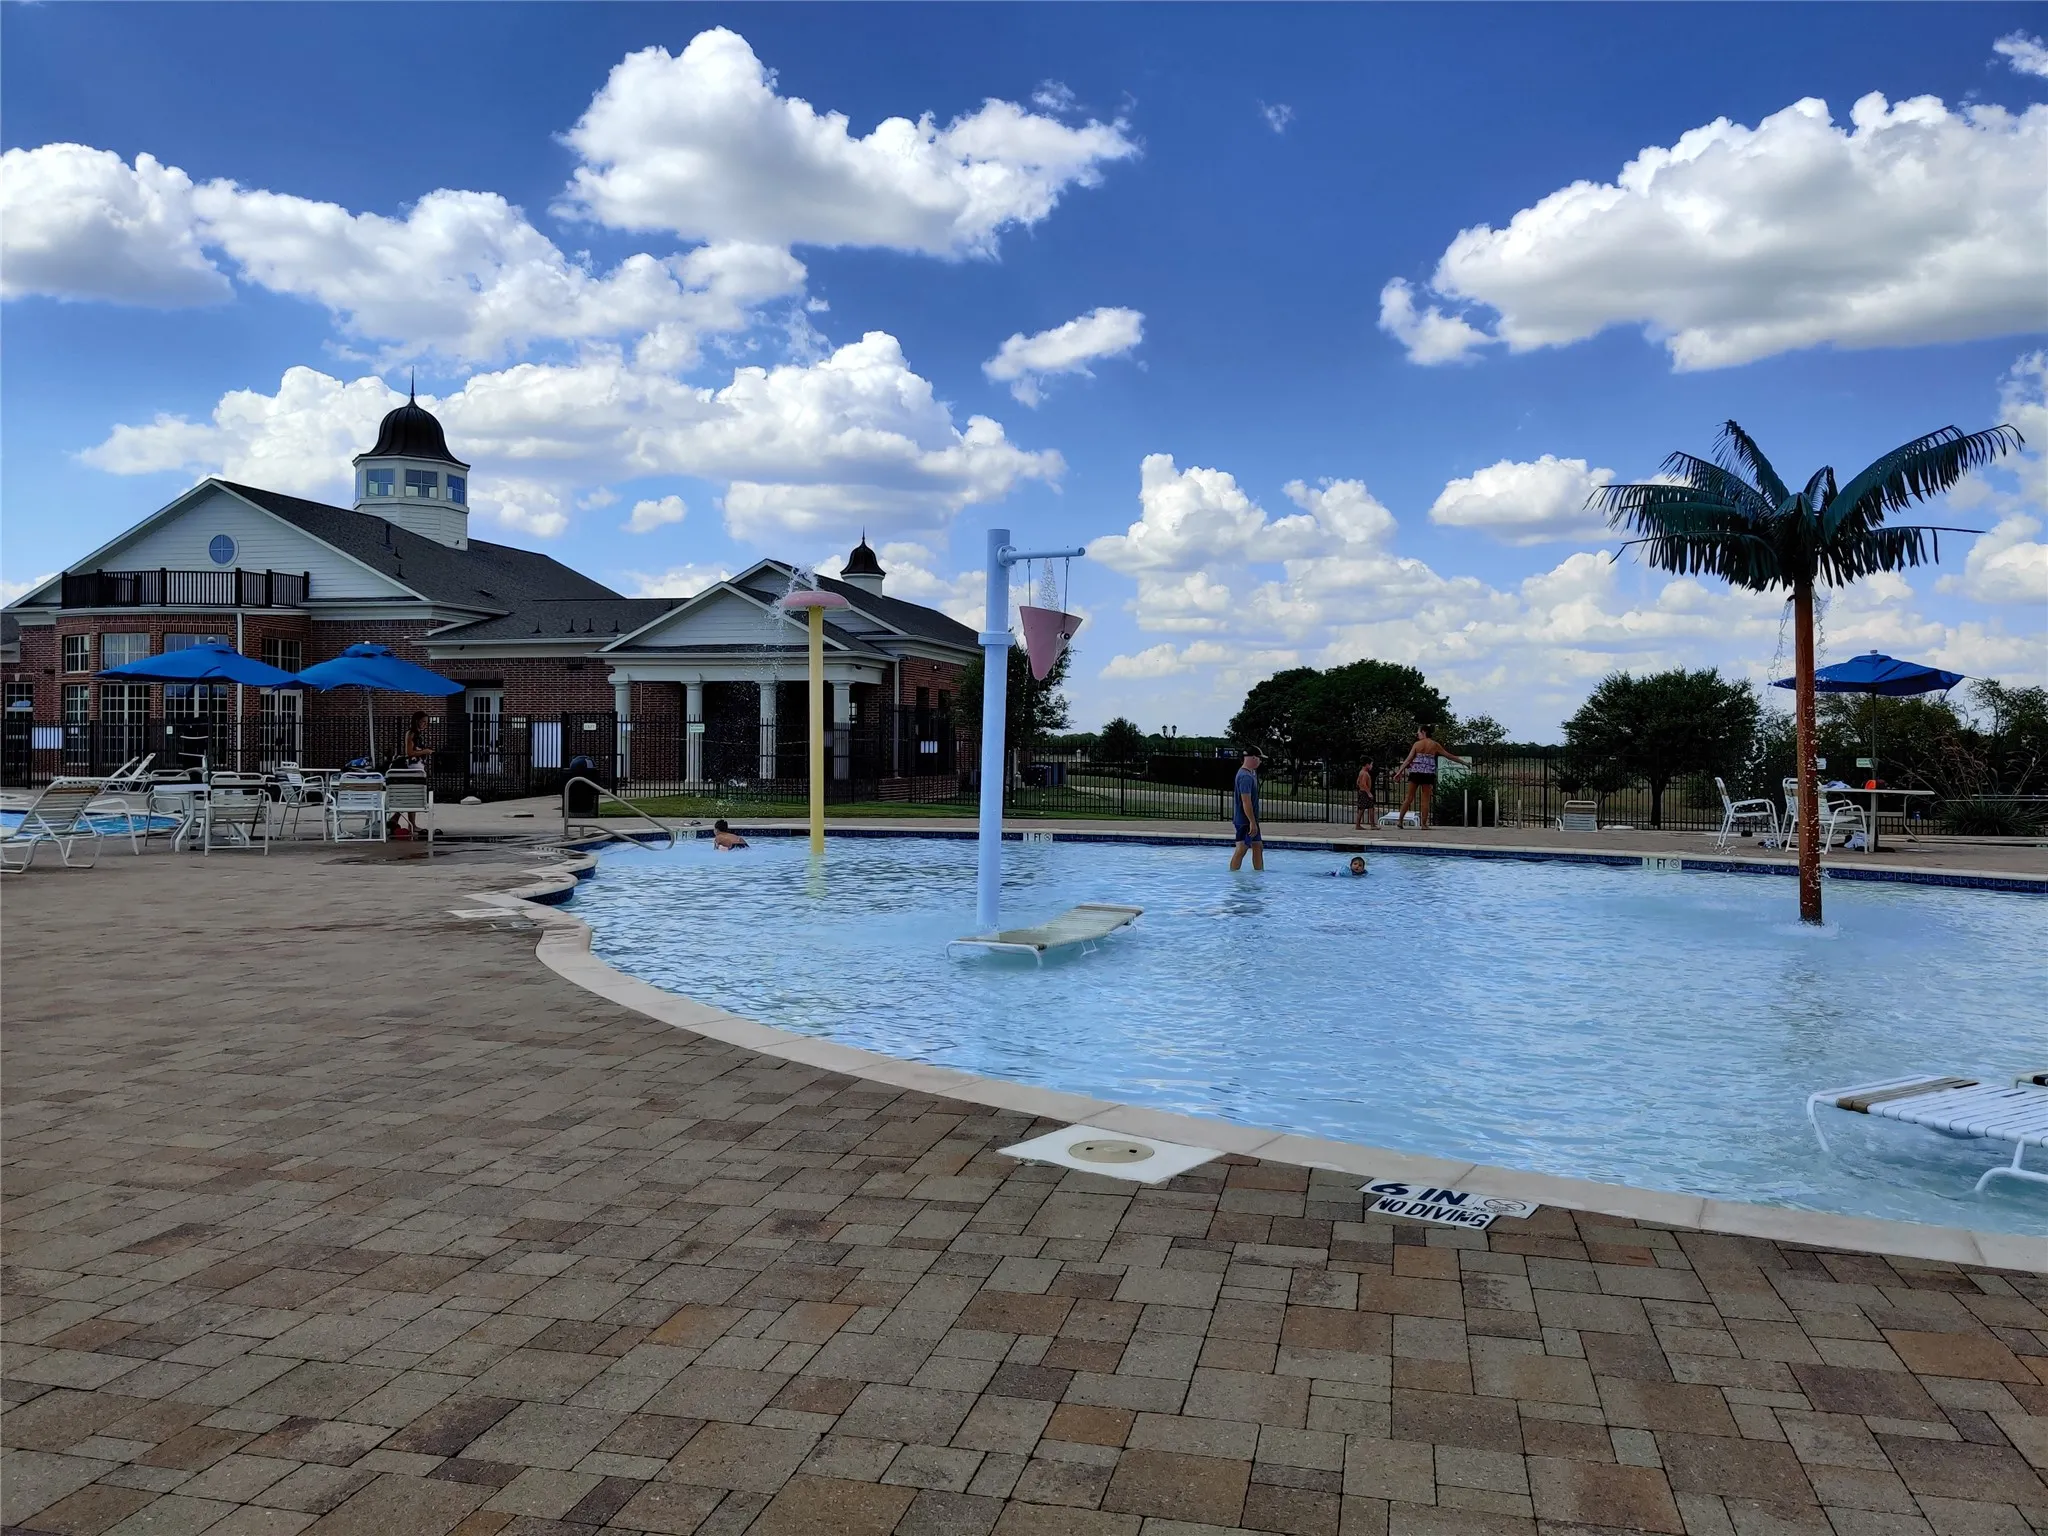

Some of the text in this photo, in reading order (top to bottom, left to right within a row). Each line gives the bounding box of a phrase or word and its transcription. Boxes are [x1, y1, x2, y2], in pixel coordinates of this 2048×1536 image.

[1034, 833, 1041, 842] FT
[1657, 858, 1666, 869] FT
[1370, 1183, 1409, 1196] 6
[1378, 1198, 1490, 1228] NO DIVING
